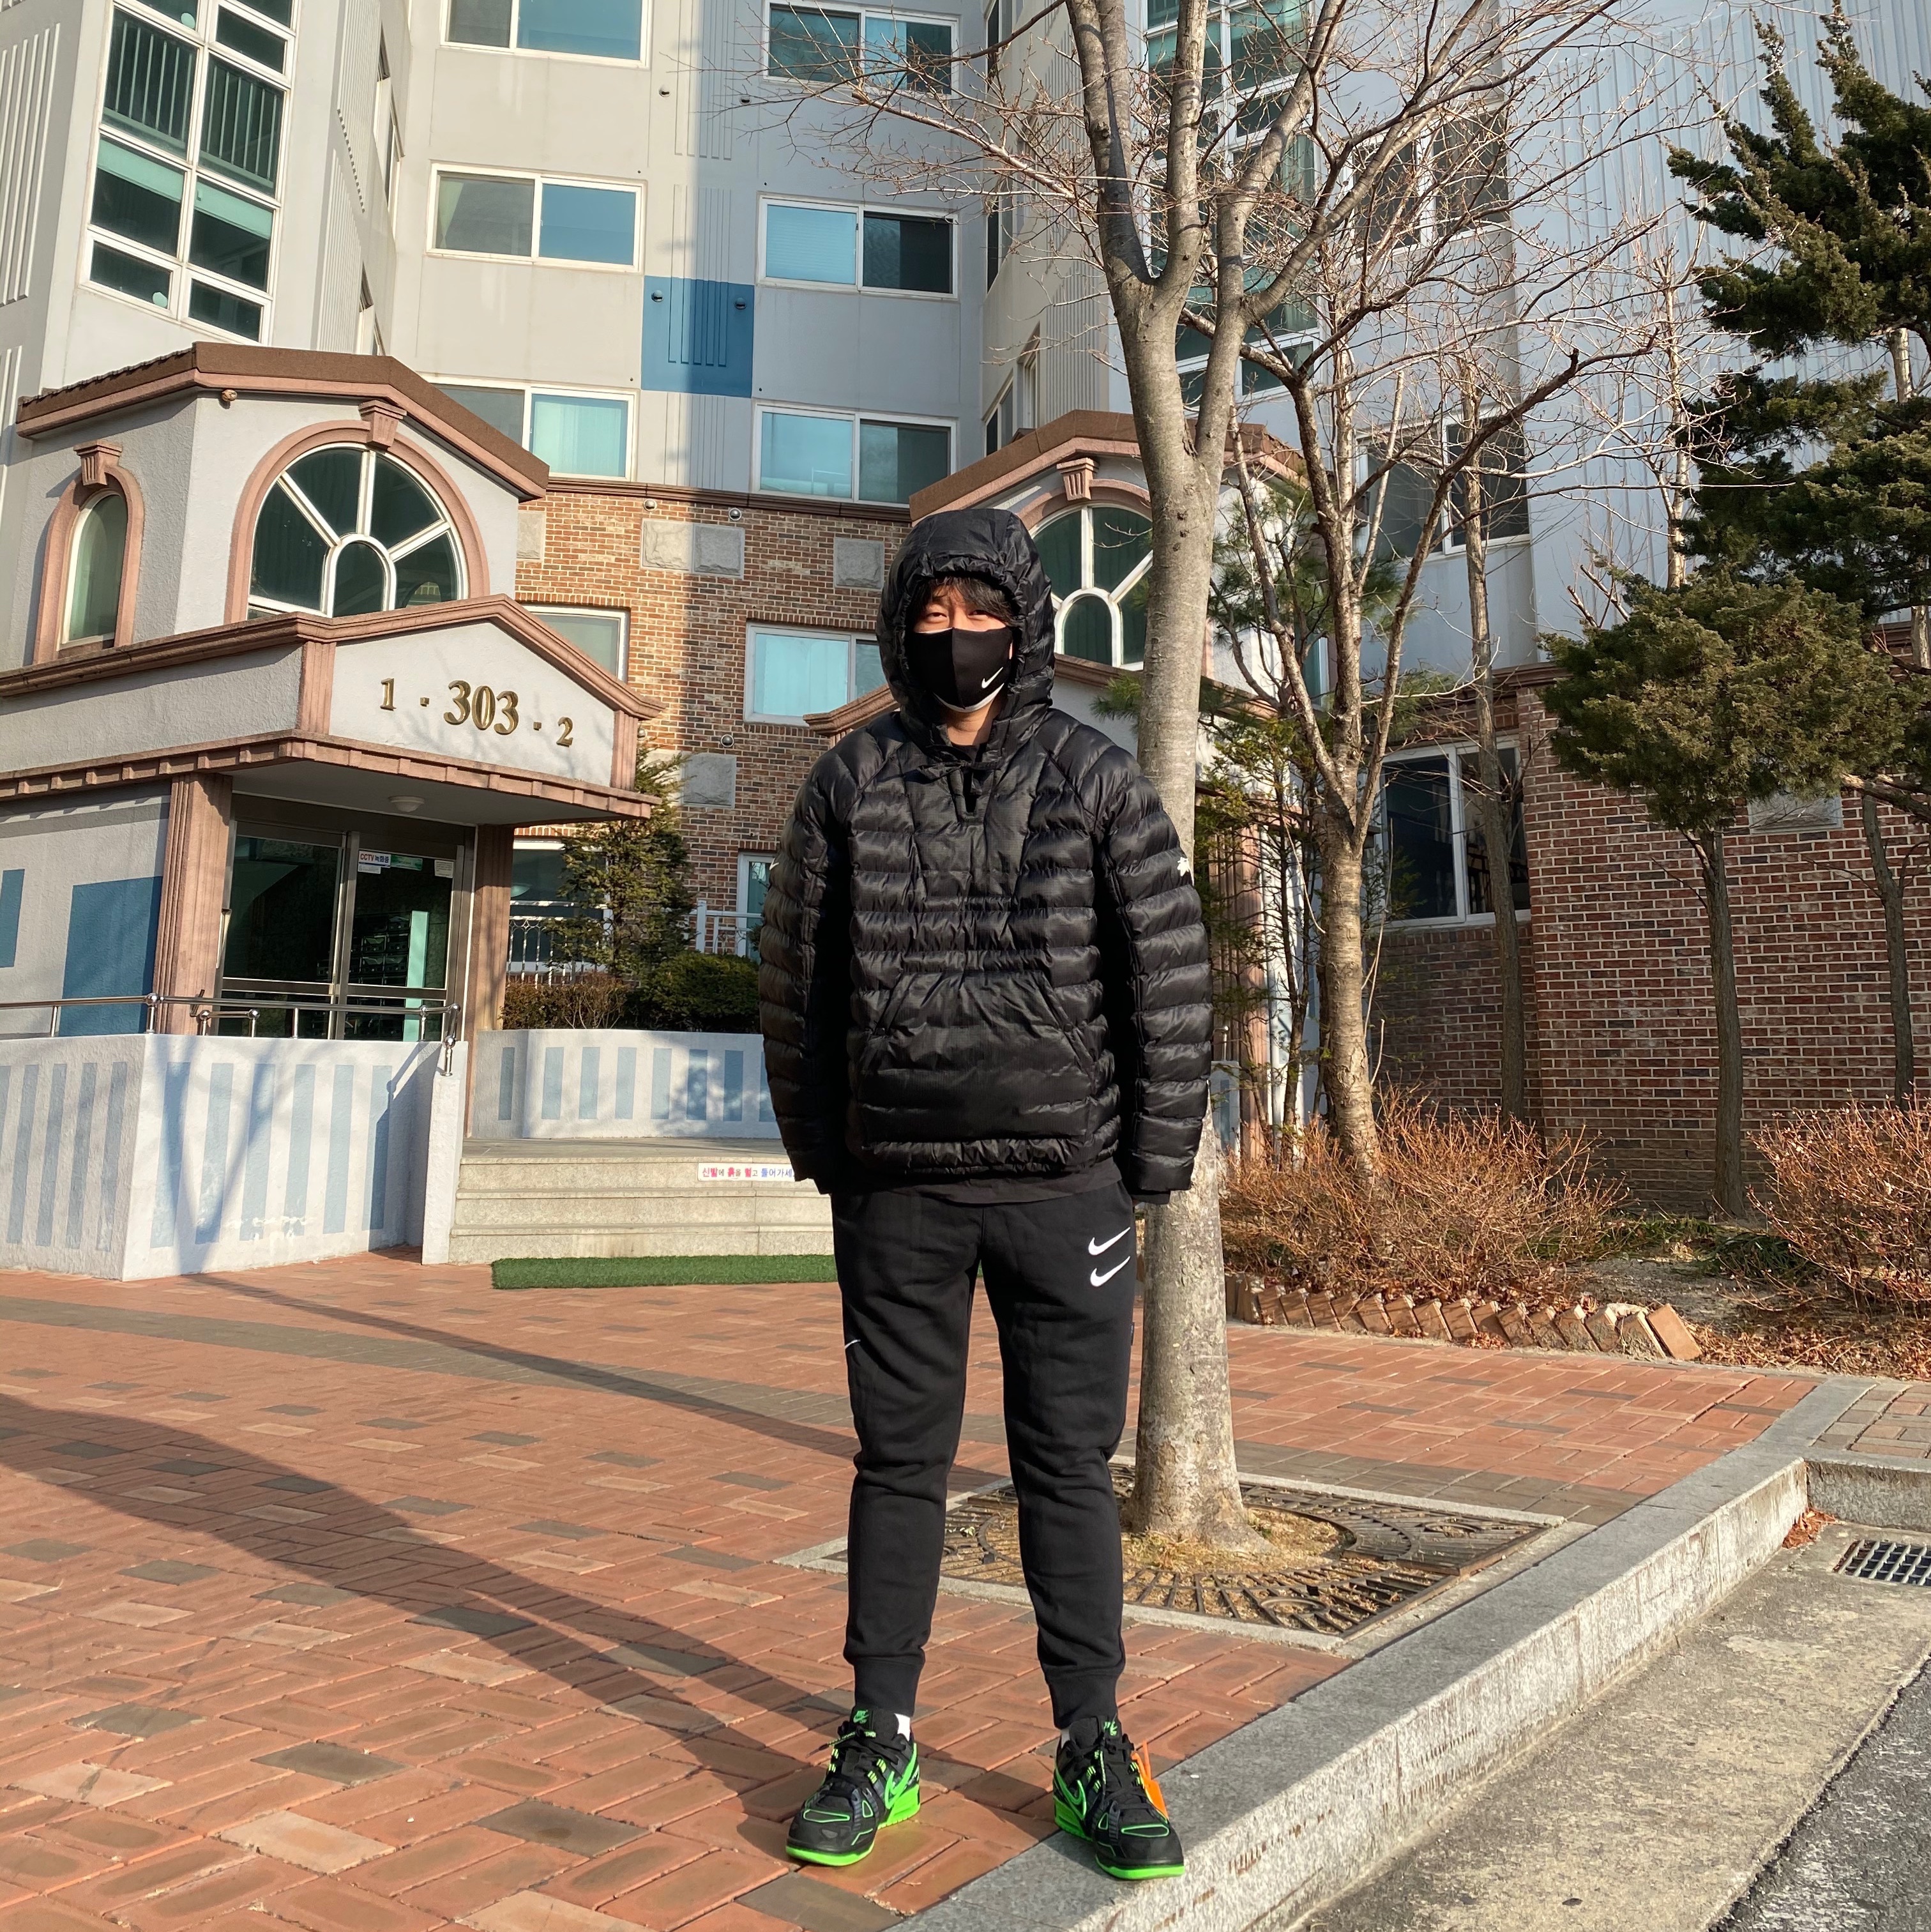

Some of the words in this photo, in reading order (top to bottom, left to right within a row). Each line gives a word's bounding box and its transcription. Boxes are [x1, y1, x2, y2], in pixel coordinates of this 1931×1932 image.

[380, 678, 397, 711] 1
[443, 680, 519, 735] 303
[556, 717, 573, 747] 2
[360, 853, 375, 862] CCTV
[761, 1168, 795, 1178] 들어가세
